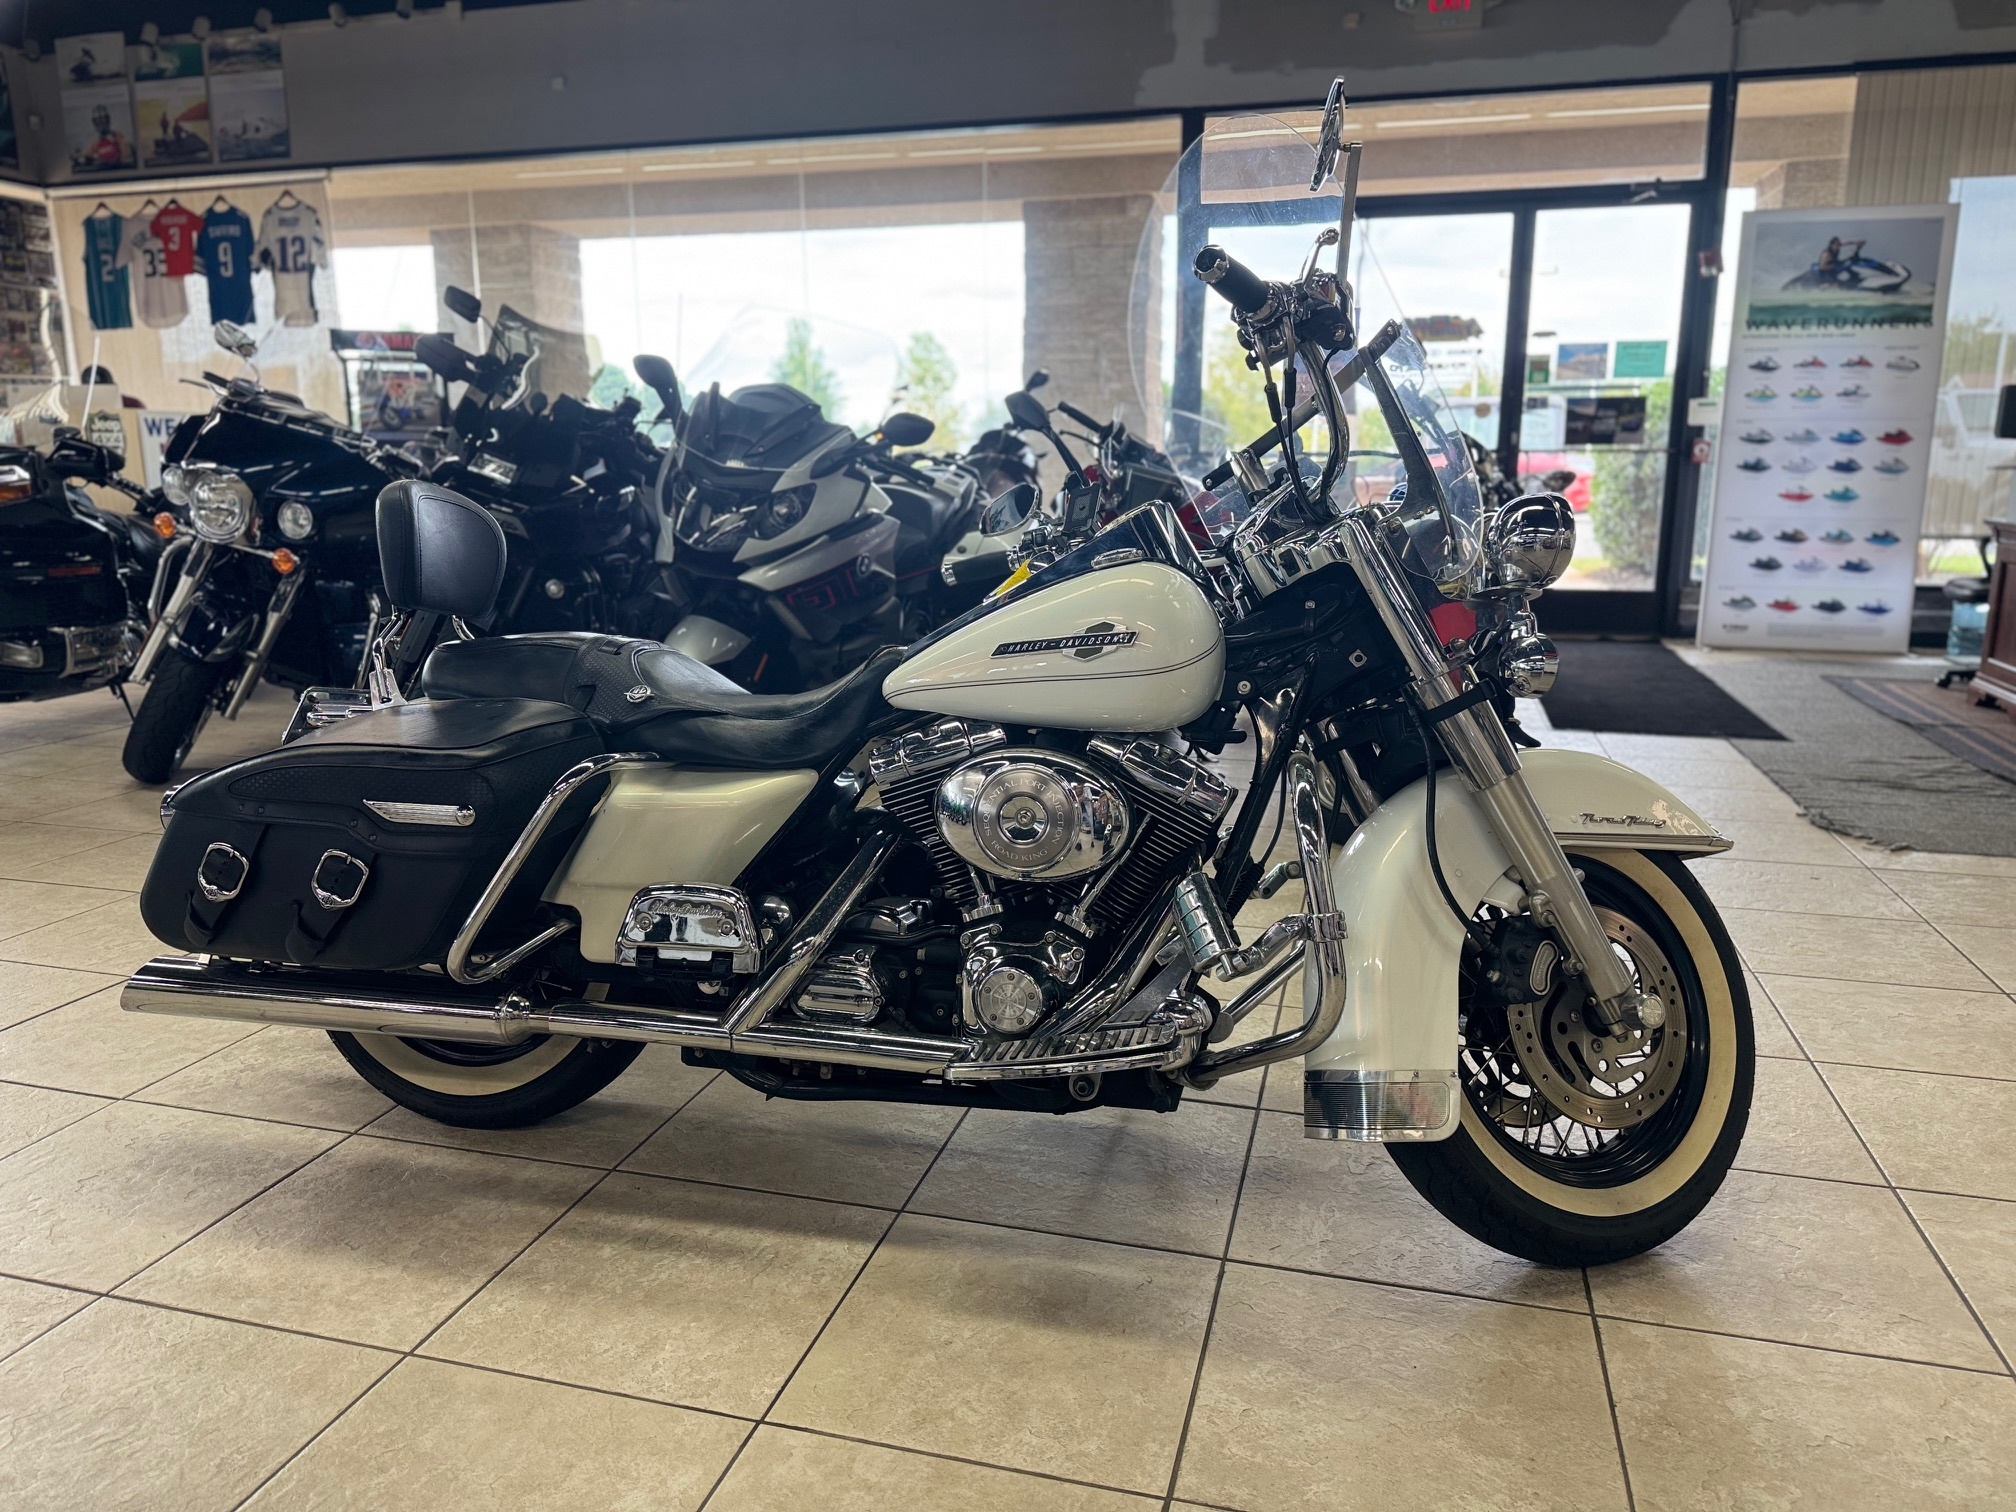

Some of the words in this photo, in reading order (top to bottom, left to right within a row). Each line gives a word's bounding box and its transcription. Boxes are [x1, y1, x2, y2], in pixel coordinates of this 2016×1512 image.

[168, 226, 180, 251] 3
[100, 253, 116, 282] 2
[217, 241, 234, 278] 9
[275, 236, 309, 273] 12
[1746, 317, 1934, 331] WAVERUNNERS
[983, 780, 1018, 837] SEQUENTIAL
[1020, 779, 1048, 791] PORT
[1047, 790, 1065, 845] INJECTION
[991, 840, 1019, 860] ROAD
[1021, 848, 1048, 861] KING
